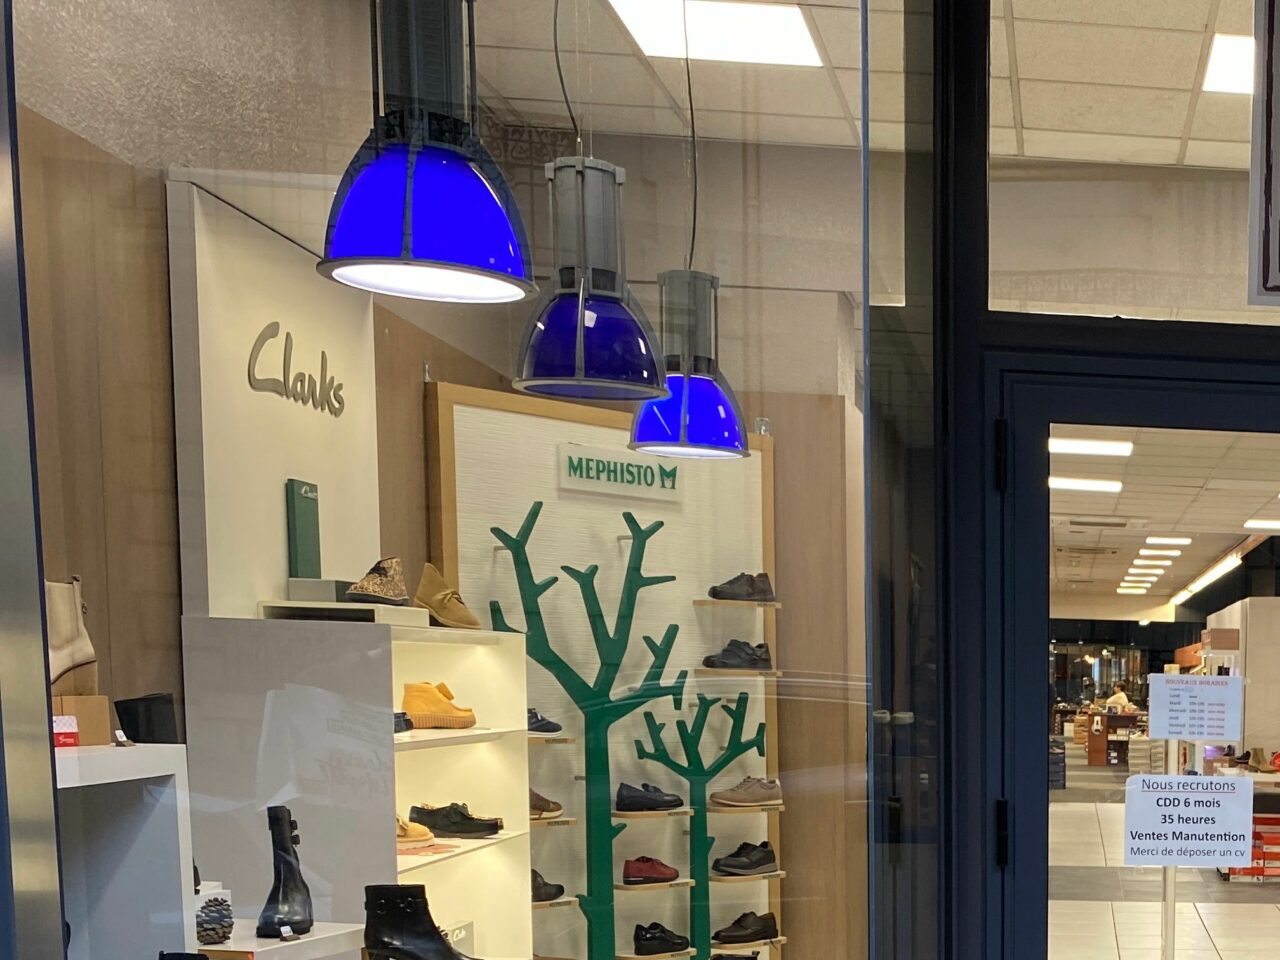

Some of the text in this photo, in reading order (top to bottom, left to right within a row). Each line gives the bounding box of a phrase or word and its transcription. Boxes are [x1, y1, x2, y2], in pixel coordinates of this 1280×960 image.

[247, 321, 345, 418] Clarks
[567, 455, 655, 487] MEPHISTO
[1142, 779, 1236, 791] Nous recrutons
[1156, 797, 1221, 808] CDD 6 mois
[1160, 814, 1216, 824] 35 heures
[1130, 830, 1246, 842] Ventes Manutention
[1130, 846, 1159, 856] Merci
[1161, 846, 1174, 856] de
[1176, 846, 1217, 858] déposer
[1220, 849, 1232, 857] un
